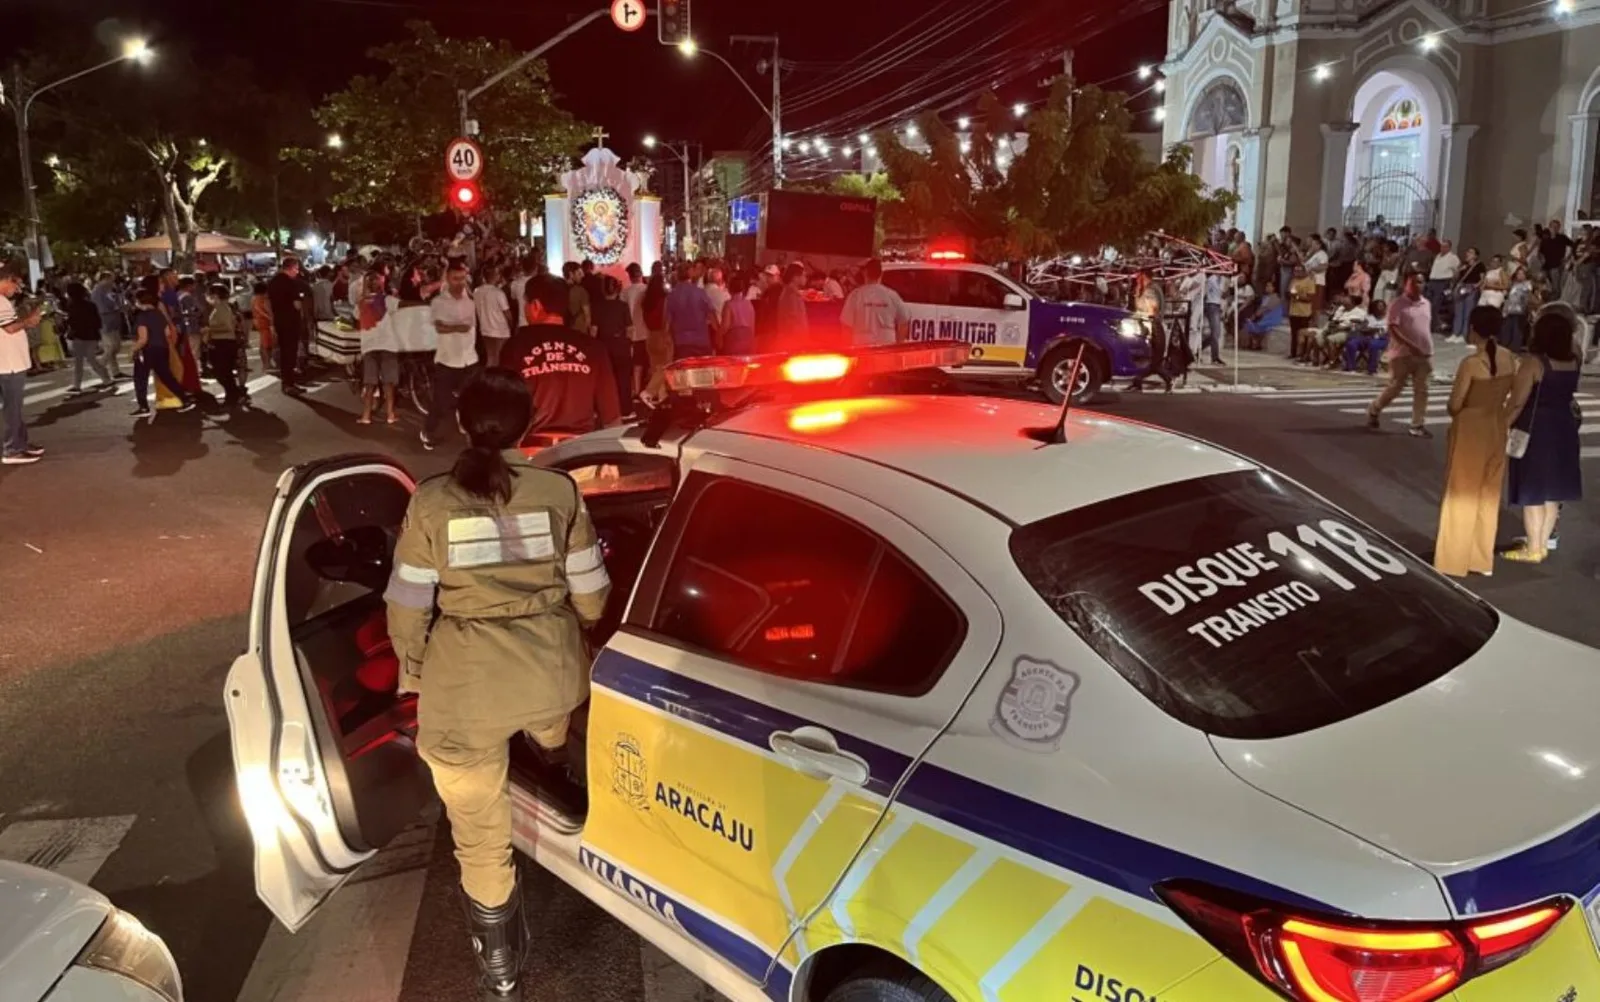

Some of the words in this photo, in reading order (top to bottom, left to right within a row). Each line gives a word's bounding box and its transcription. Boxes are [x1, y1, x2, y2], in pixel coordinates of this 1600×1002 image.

[453, 149, 474, 167] 40
[939, 321, 996, 344] MILITAR
[523, 341, 587, 366] AGENTE
[546, 352, 565, 361] DE
[1138, 542, 1279, 615] DISQUE
[1267, 519, 1407, 591] 118
[1187, 581, 1320, 648] TRANSITO
[655, 782, 753, 851] ARACAJU
